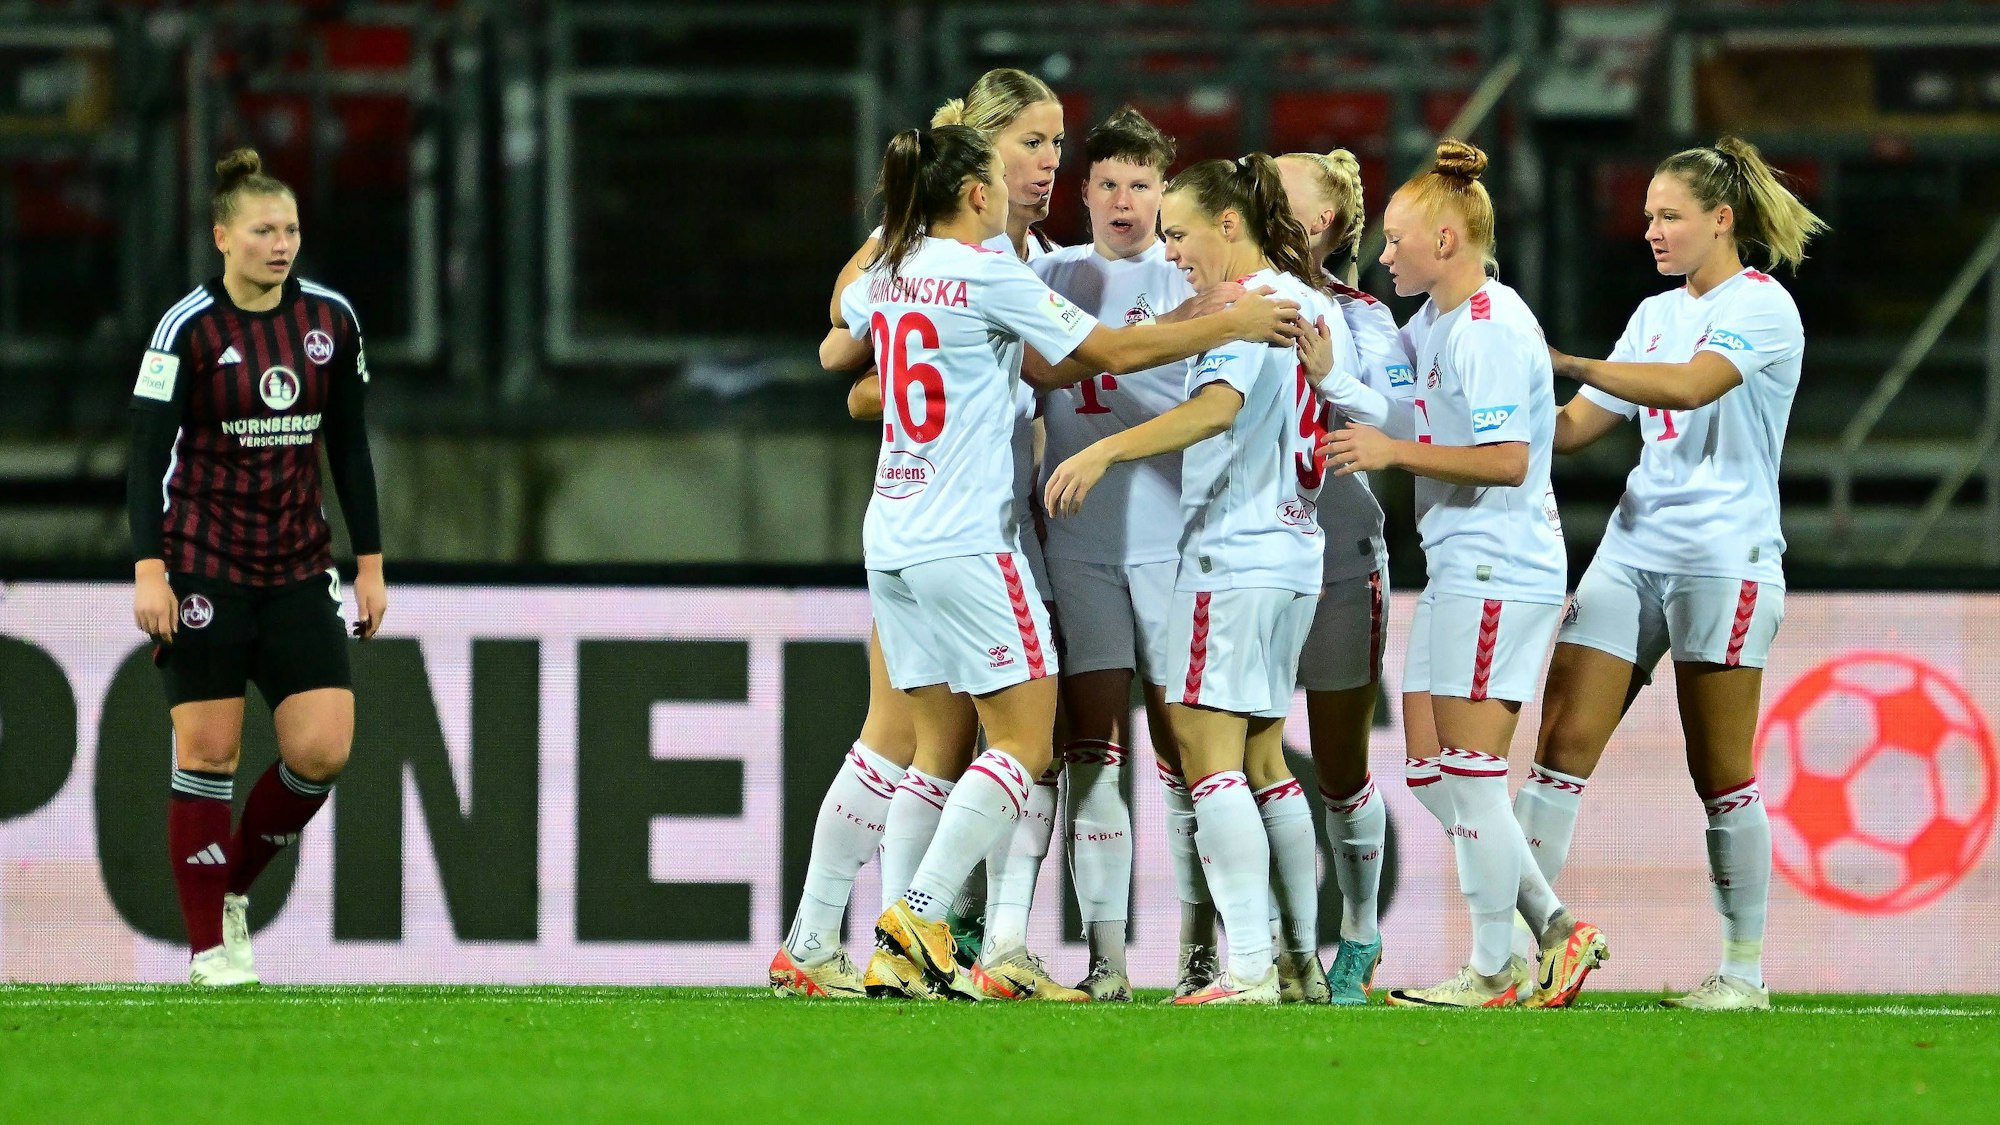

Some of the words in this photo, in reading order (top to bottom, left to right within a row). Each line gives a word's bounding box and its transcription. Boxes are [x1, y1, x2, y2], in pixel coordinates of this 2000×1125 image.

[1712, 332, 1745, 350] SAP
[141, 375, 166, 390] Pixel
[1473, 410, 1509, 429] SAP
[1087, 830, 1124, 842] KÖLN
